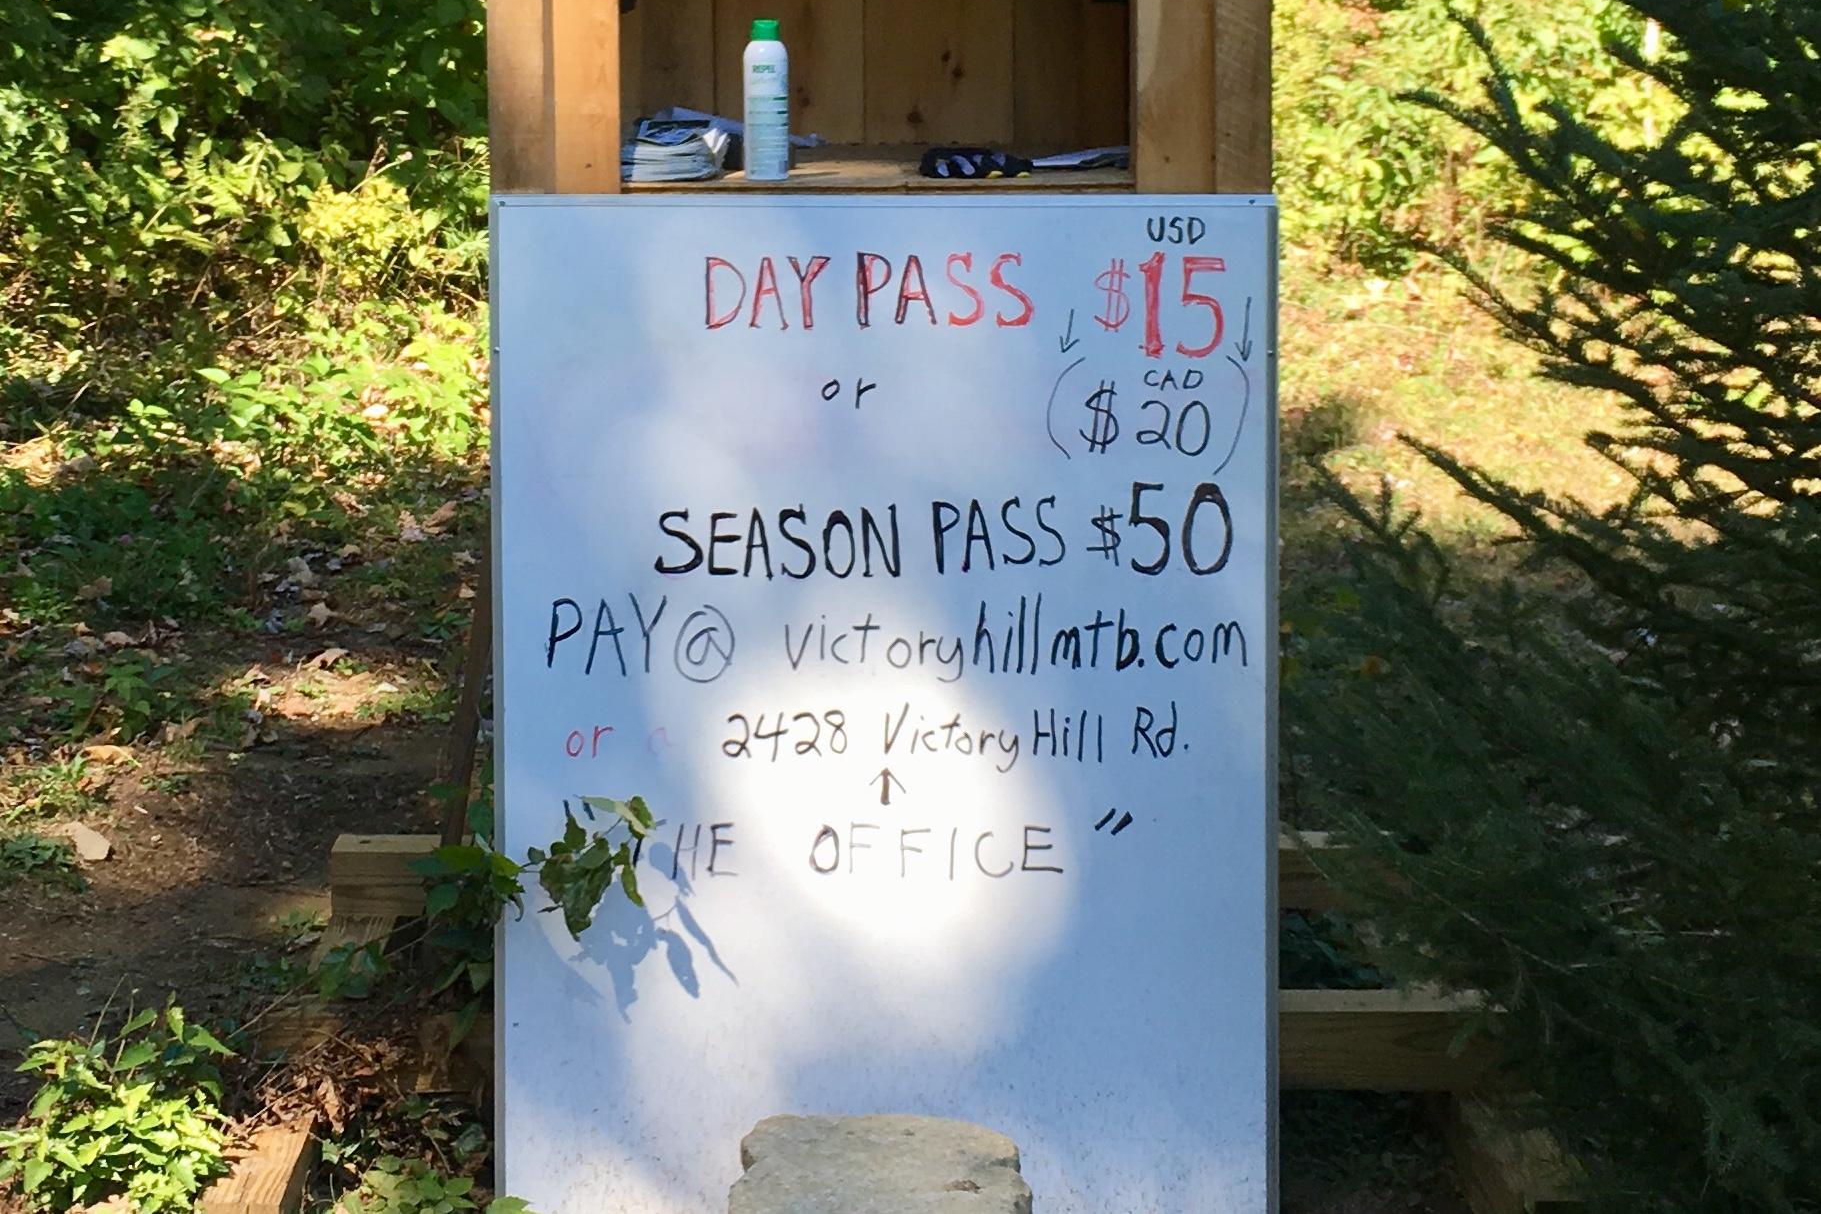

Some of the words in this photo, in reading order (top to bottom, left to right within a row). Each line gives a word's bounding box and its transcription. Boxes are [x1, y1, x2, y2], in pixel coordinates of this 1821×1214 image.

[1147, 216, 1205, 245] USD
[705, 253, 831, 330] DAY
[857, 252, 1034, 330] PASS
[1095, 252, 1230, 360] $15
[821, 380, 877, 409] or
[1144, 369, 1203, 391] CAD
[654, 503, 901, 581] SEASON
[932, 495, 1065, 575] PASS
[1086, 482, 1234, 576] $50
[566, 725, 614, 759] or
[722, 711, 847, 762] 2428
[883, 702, 1020, 770] Victory
[1033, 708, 1103, 762] Hill
[1132, 701, 1189, 759] Rd.
